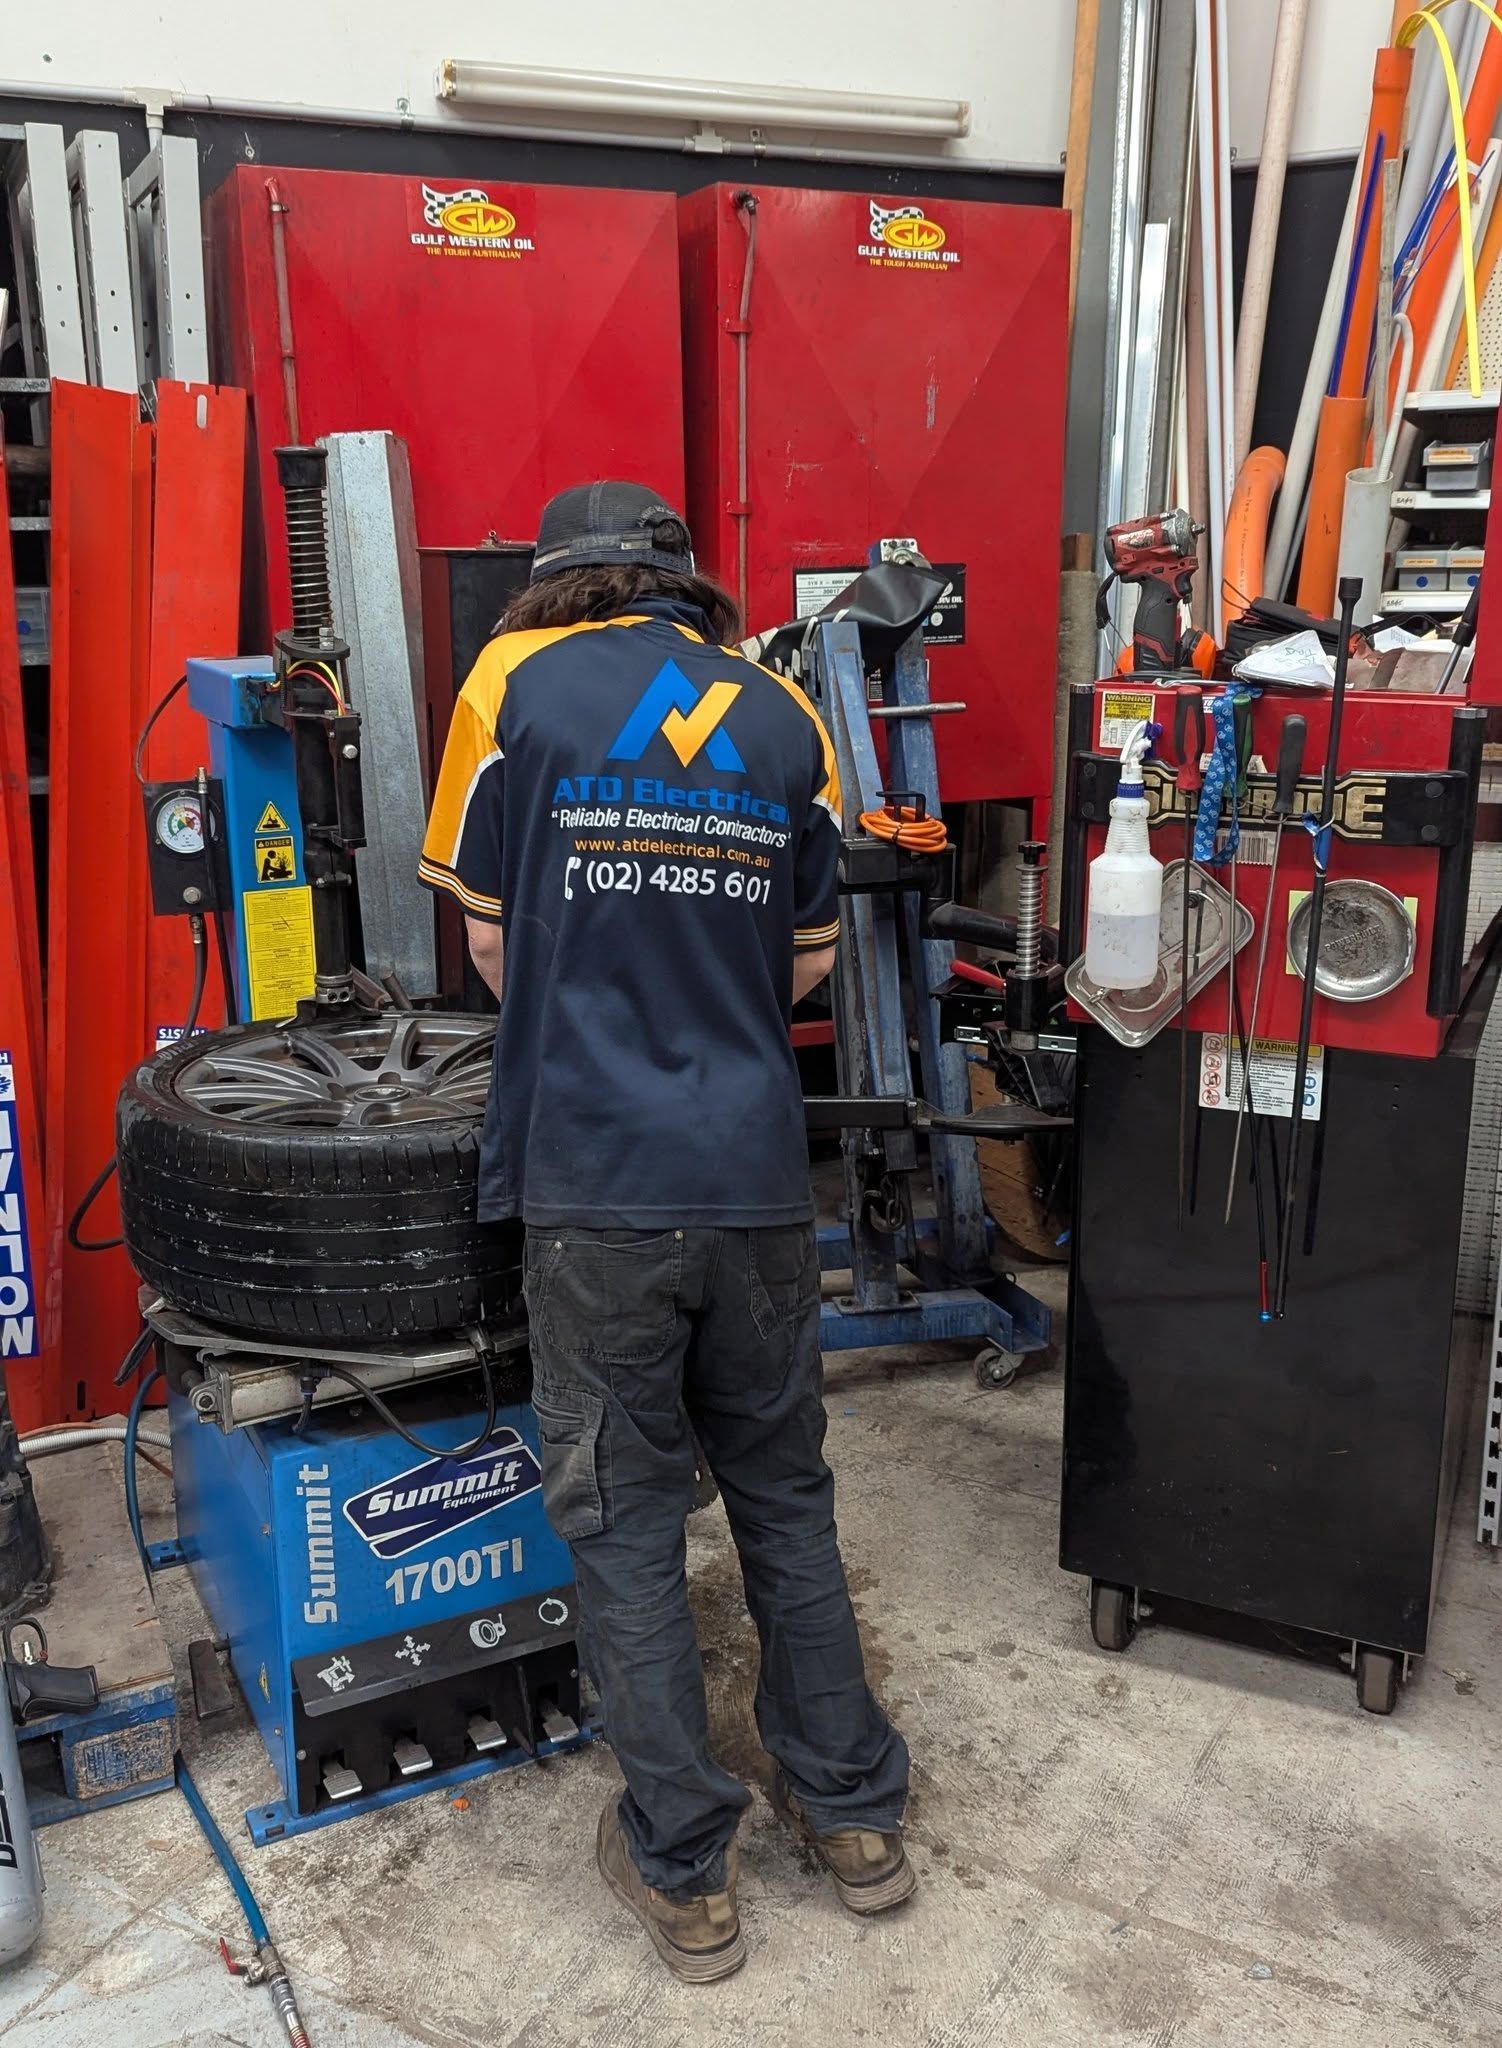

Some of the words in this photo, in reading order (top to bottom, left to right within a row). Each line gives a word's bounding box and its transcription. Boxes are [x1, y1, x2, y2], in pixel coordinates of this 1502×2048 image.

[411, 233, 446, 246] GULF
[448, 234, 511, 249] WESTERN
[513, 238, 536, 251] OIL
[426, 247, 441, 256] THE
[444, 247, 471, 257] TOUGH
[472, 249, 521, 260] AUSTRALIAN
[858, 245, 886, 257] GULF
[888, 247, 940, 261] WESTERN
[942, 251, 961, 263] OIL
[870, 258, 881, 266] THE
[883, 258, 905, 268] TOUGH
[906, 260, 949, 271] AUSTRALIAN
[1106, 694, 1152, 703] WARNING
[552, 776, 622, 804] ATD
[633, 776, 790, 824] Electrica
[625, 808, 700, 834] Electrical
[586, 860, 642, 894] (02)
[649, 864, 716, 895] 4285
[724, 871, 771, 905] 601
[366, 1460, 523, 1519] Summit
[442, 1483, 516, 1511] Equipment
[296, 1464, 338, 1624] Summit
[385, 1537, 523, 1606] 1700TI
